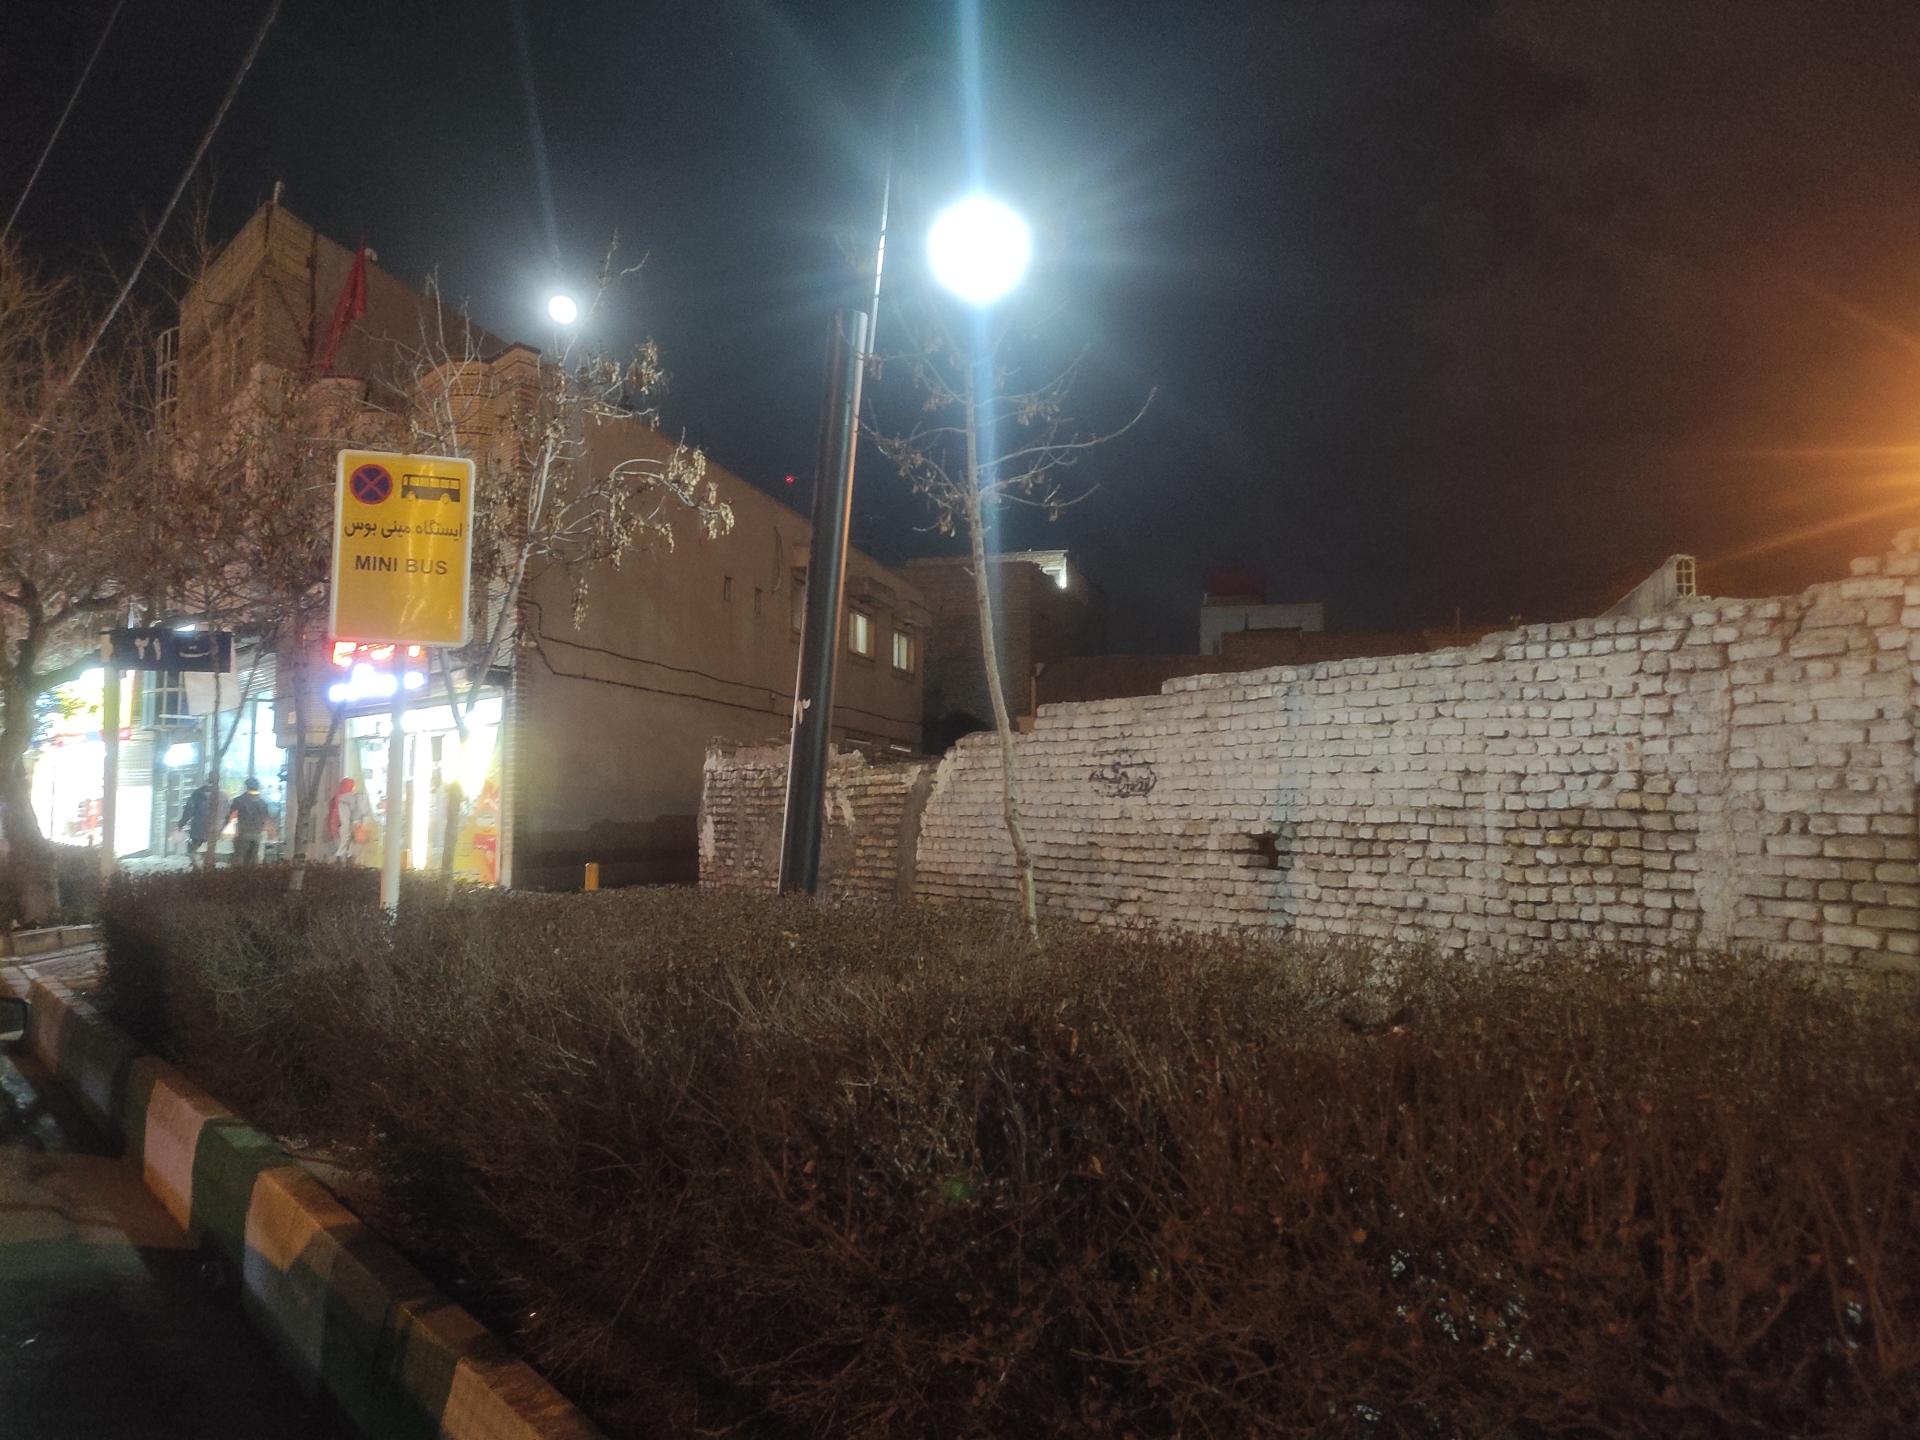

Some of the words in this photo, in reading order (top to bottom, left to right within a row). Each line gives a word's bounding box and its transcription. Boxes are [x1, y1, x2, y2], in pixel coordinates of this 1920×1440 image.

[344, 520, 377, 537] بوس
[381, 521, 411, 538] مینی
[415, 520, 463, 541] ایستگاه
[355, 555, 398, 572] MINI
[406, 559, 448, 575] BUS
